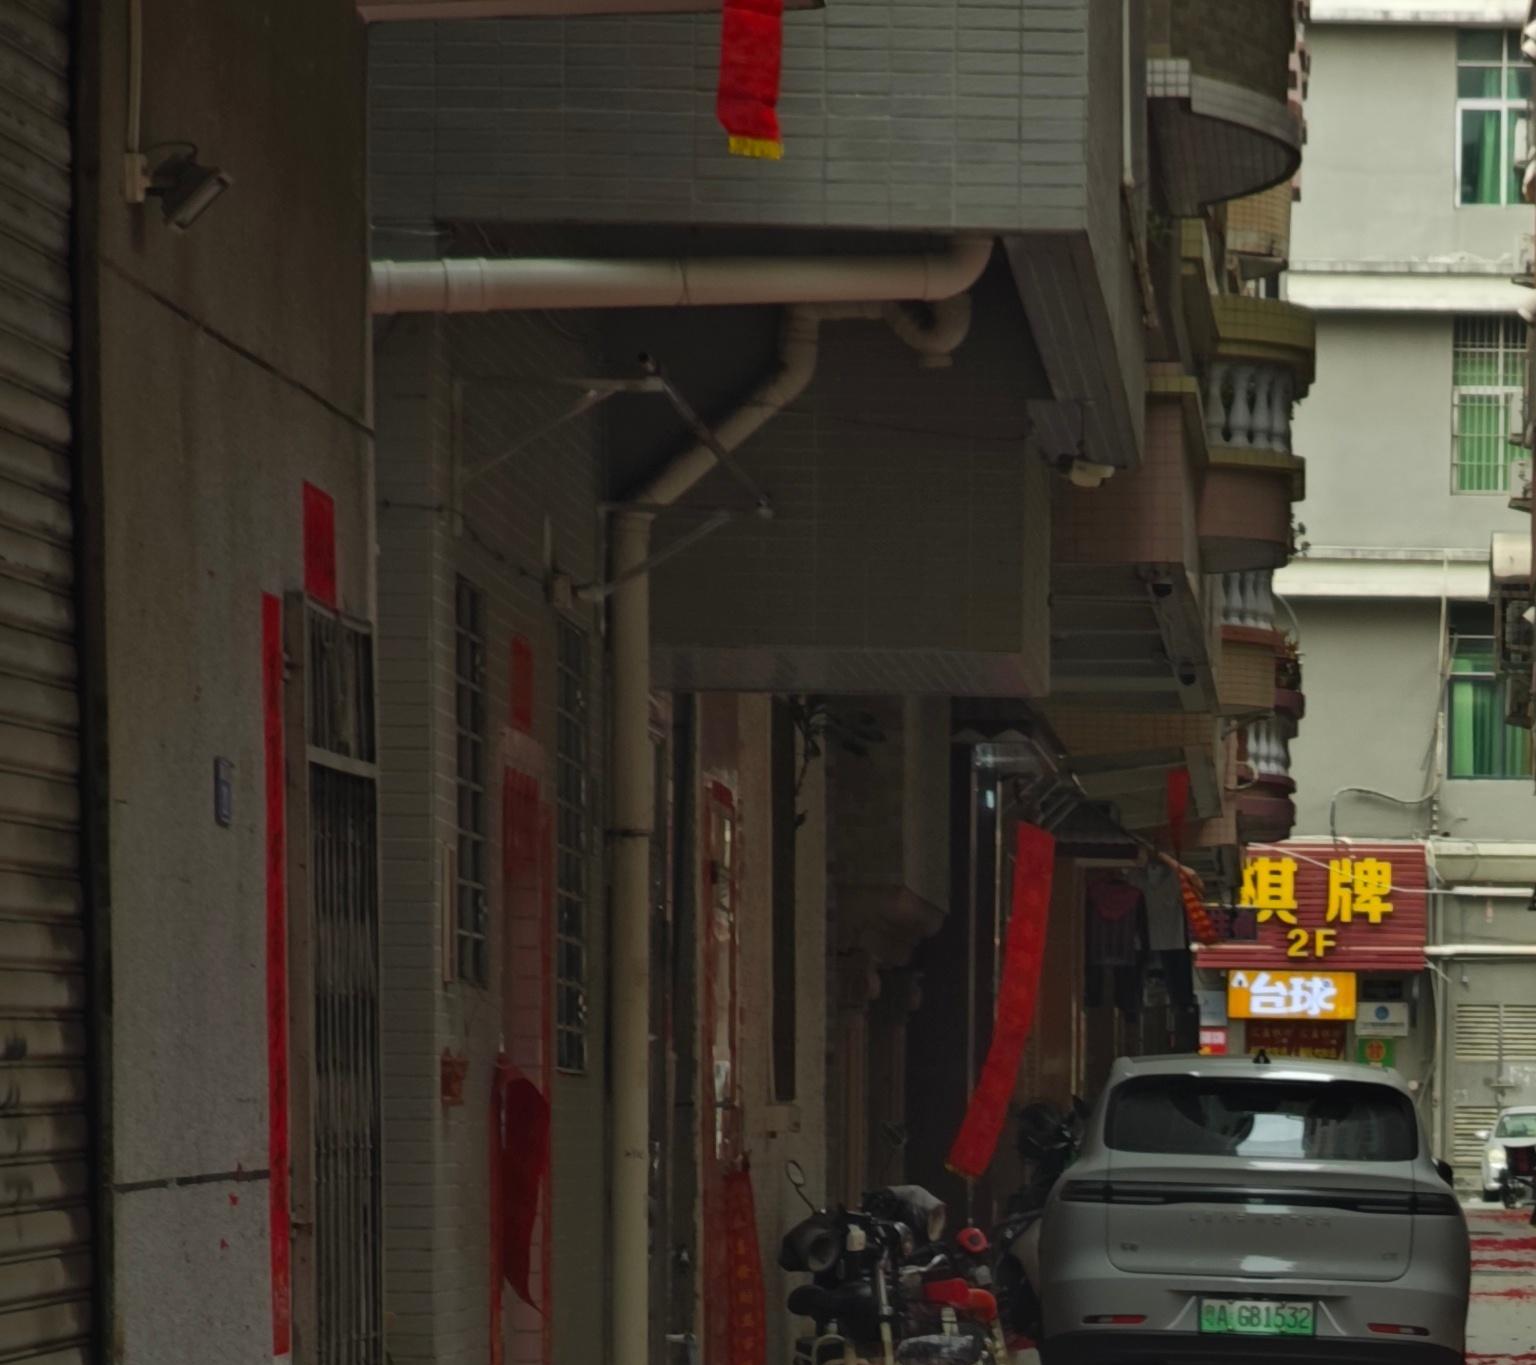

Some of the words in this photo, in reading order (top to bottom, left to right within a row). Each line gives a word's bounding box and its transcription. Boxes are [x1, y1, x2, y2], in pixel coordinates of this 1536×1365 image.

[1239, 857, 1394, 924] 棋牌
[1286, 928, 1337, 958] 2F
[1249, 972, 1338, 1017] 台球
